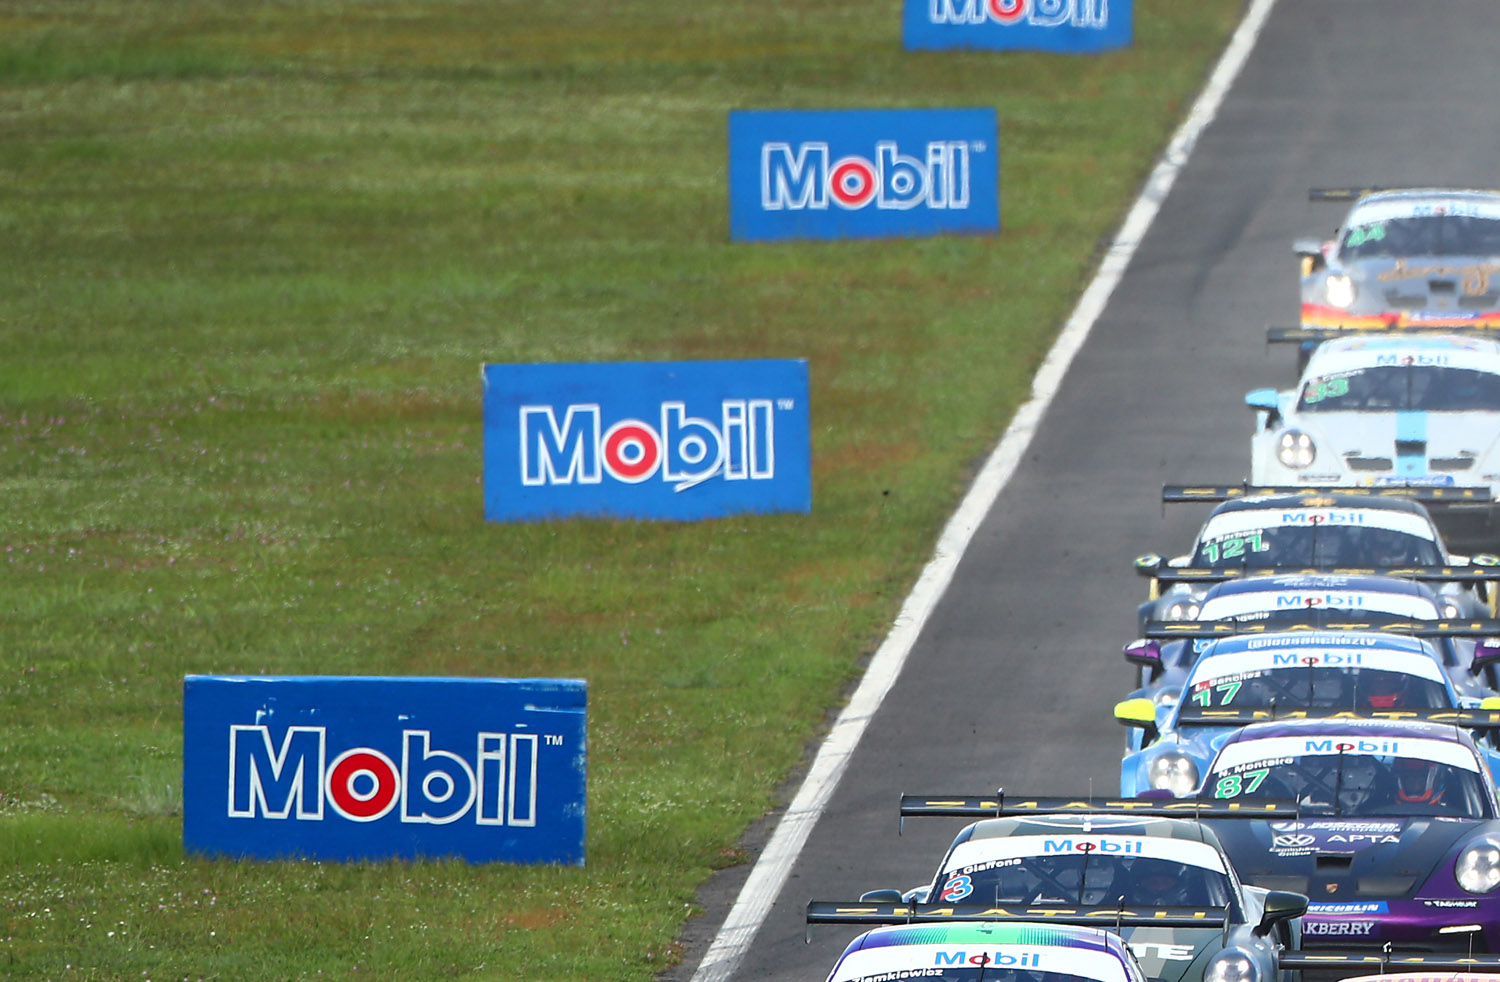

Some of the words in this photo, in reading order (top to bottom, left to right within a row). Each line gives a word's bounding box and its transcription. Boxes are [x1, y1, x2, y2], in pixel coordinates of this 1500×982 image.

[761, 140, 969, 211] Mobil
[1413, 205, 1479, 216] Mobil
[1376, 354, 1448, 366] Mobil
[519, 399, 775, 486] Mobil
[1282, 513, 1364, 525] Mobil
[1202, 535, 1264, 563] 121
[1276, 594, 1363, 608] Mobil
[1272, 652, 1362, 665] Mobil
[1192, 682, 1243, 707] 17
[1305, 740, 1399, 753] Mobil
[227, 724, 539, 828] Mobil
[1215, 768, 1270, 799] 87
[1044, 839, 1142, 854] Mobil
[1326, 834, 1401, 844] APTA
[943, 875, 974, 902] 3
[1307, 903, 1378, 913] MICHELIN
[934, 951, 1040, 967] Mobil
